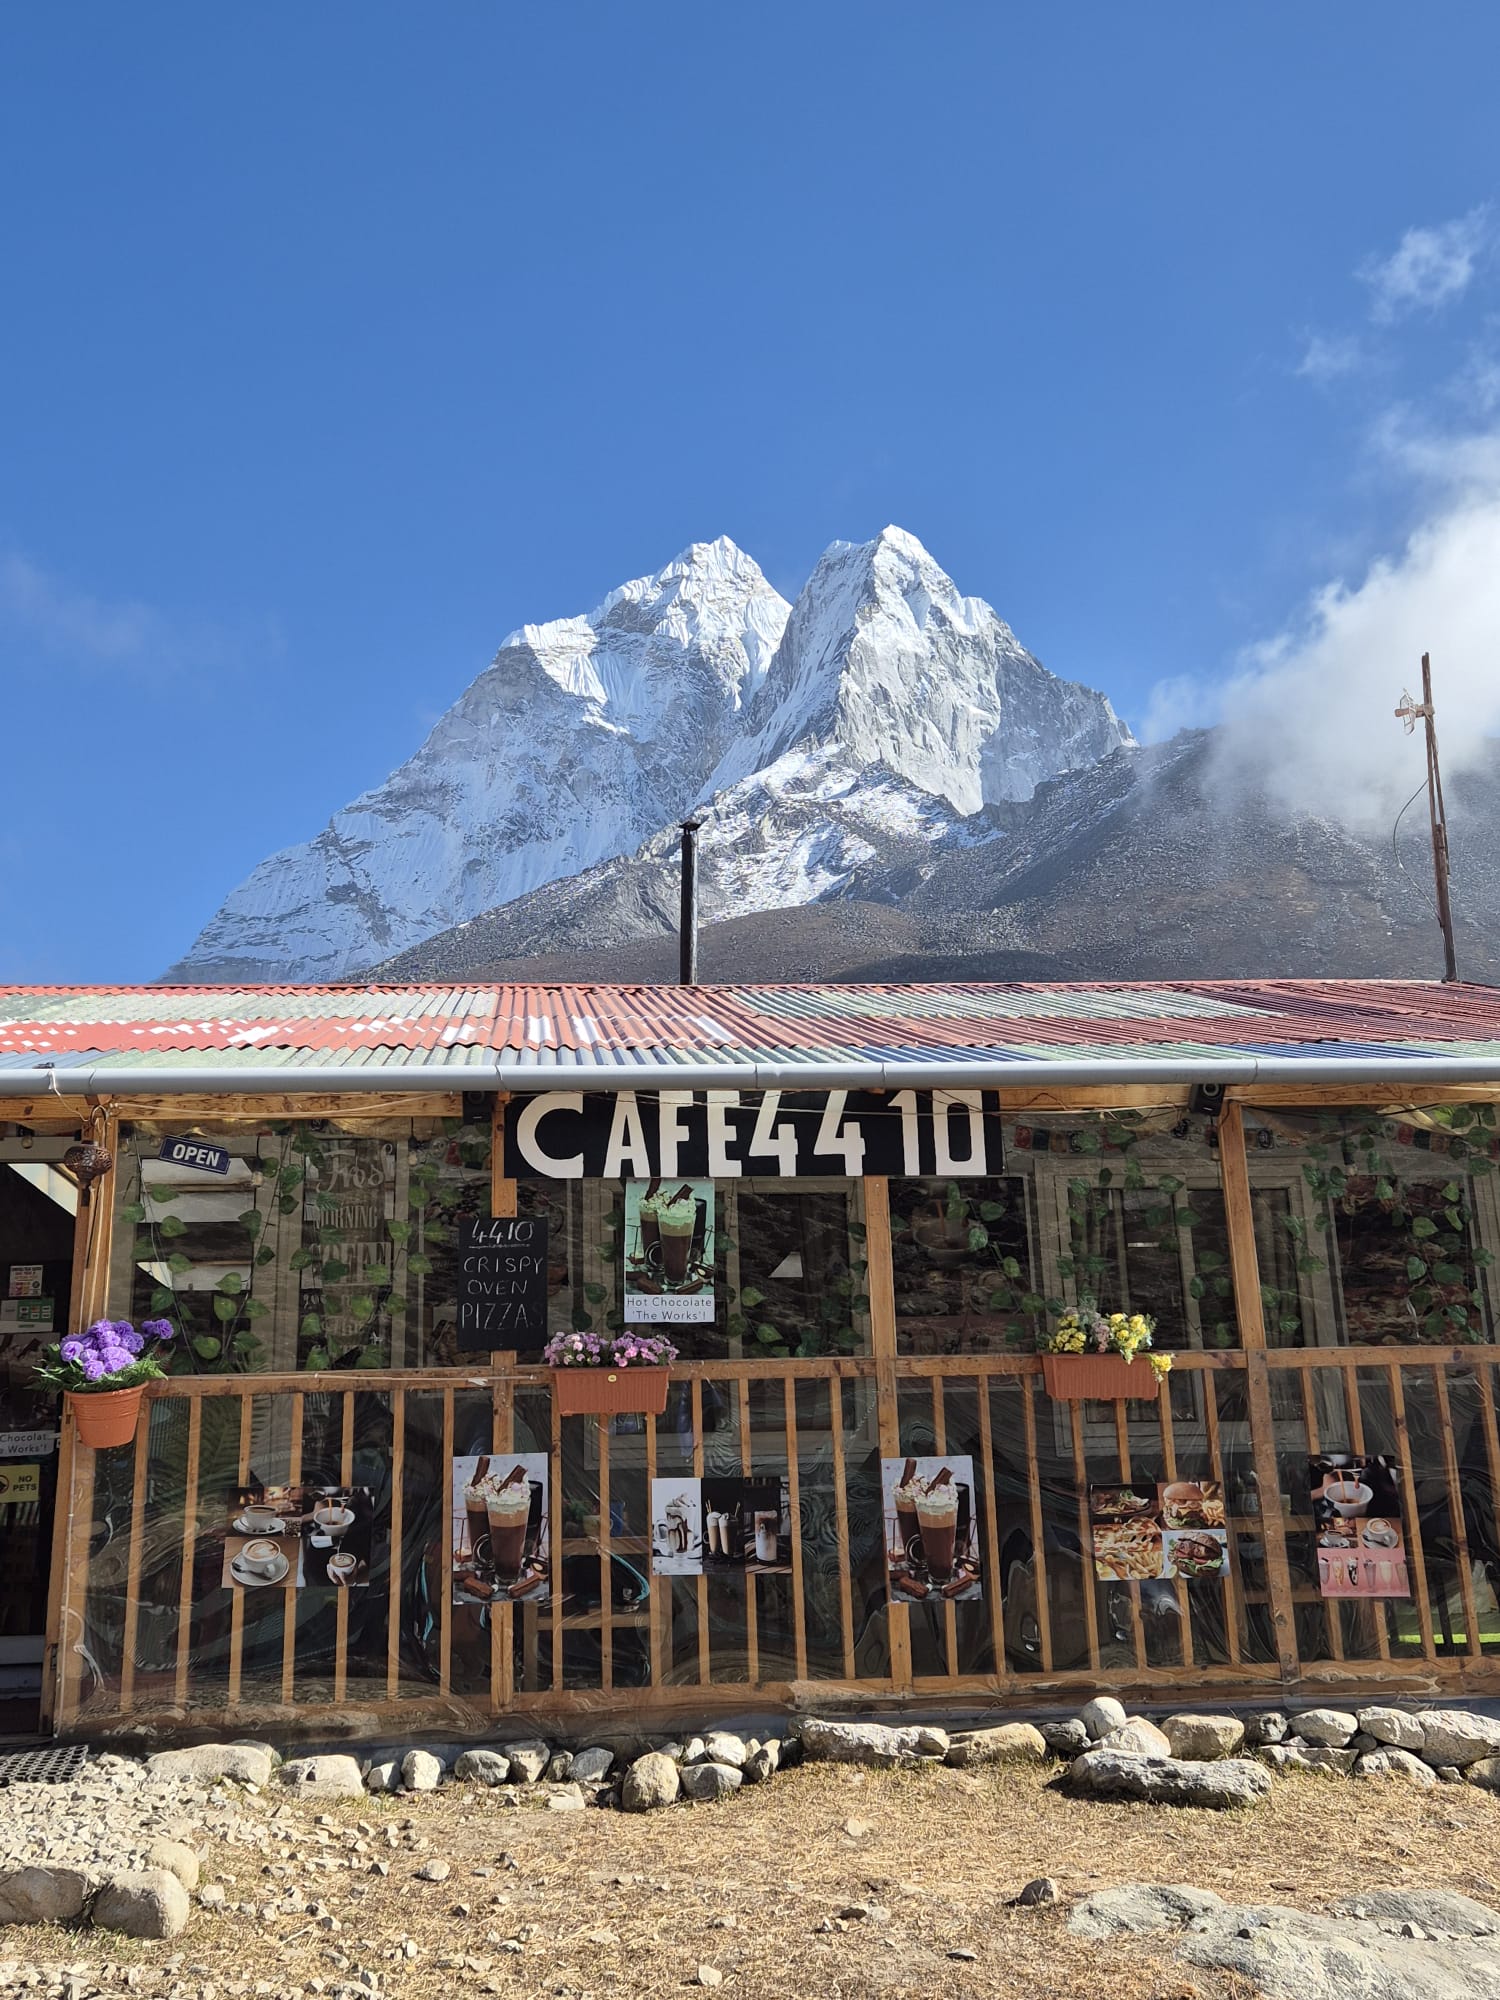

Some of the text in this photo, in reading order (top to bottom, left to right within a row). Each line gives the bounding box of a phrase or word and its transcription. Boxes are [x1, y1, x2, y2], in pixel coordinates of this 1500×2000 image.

[172, 1143, 220, 1167] OPEN
[472, 1219, 535, 1245] 4410
[463, 1256, 544, 1275] CRISPY
[467, 1279, 528, 1296] OVEN
[627, 1297, 712, 1308] Hot Chocolate
[632, 1310, 706, 1321] 'The Works'!
[0, 1431, 47, 1443] Chocolat
[18, 1475, 33, 1483] NO
[13, 1483, 38, 1492] PETS
